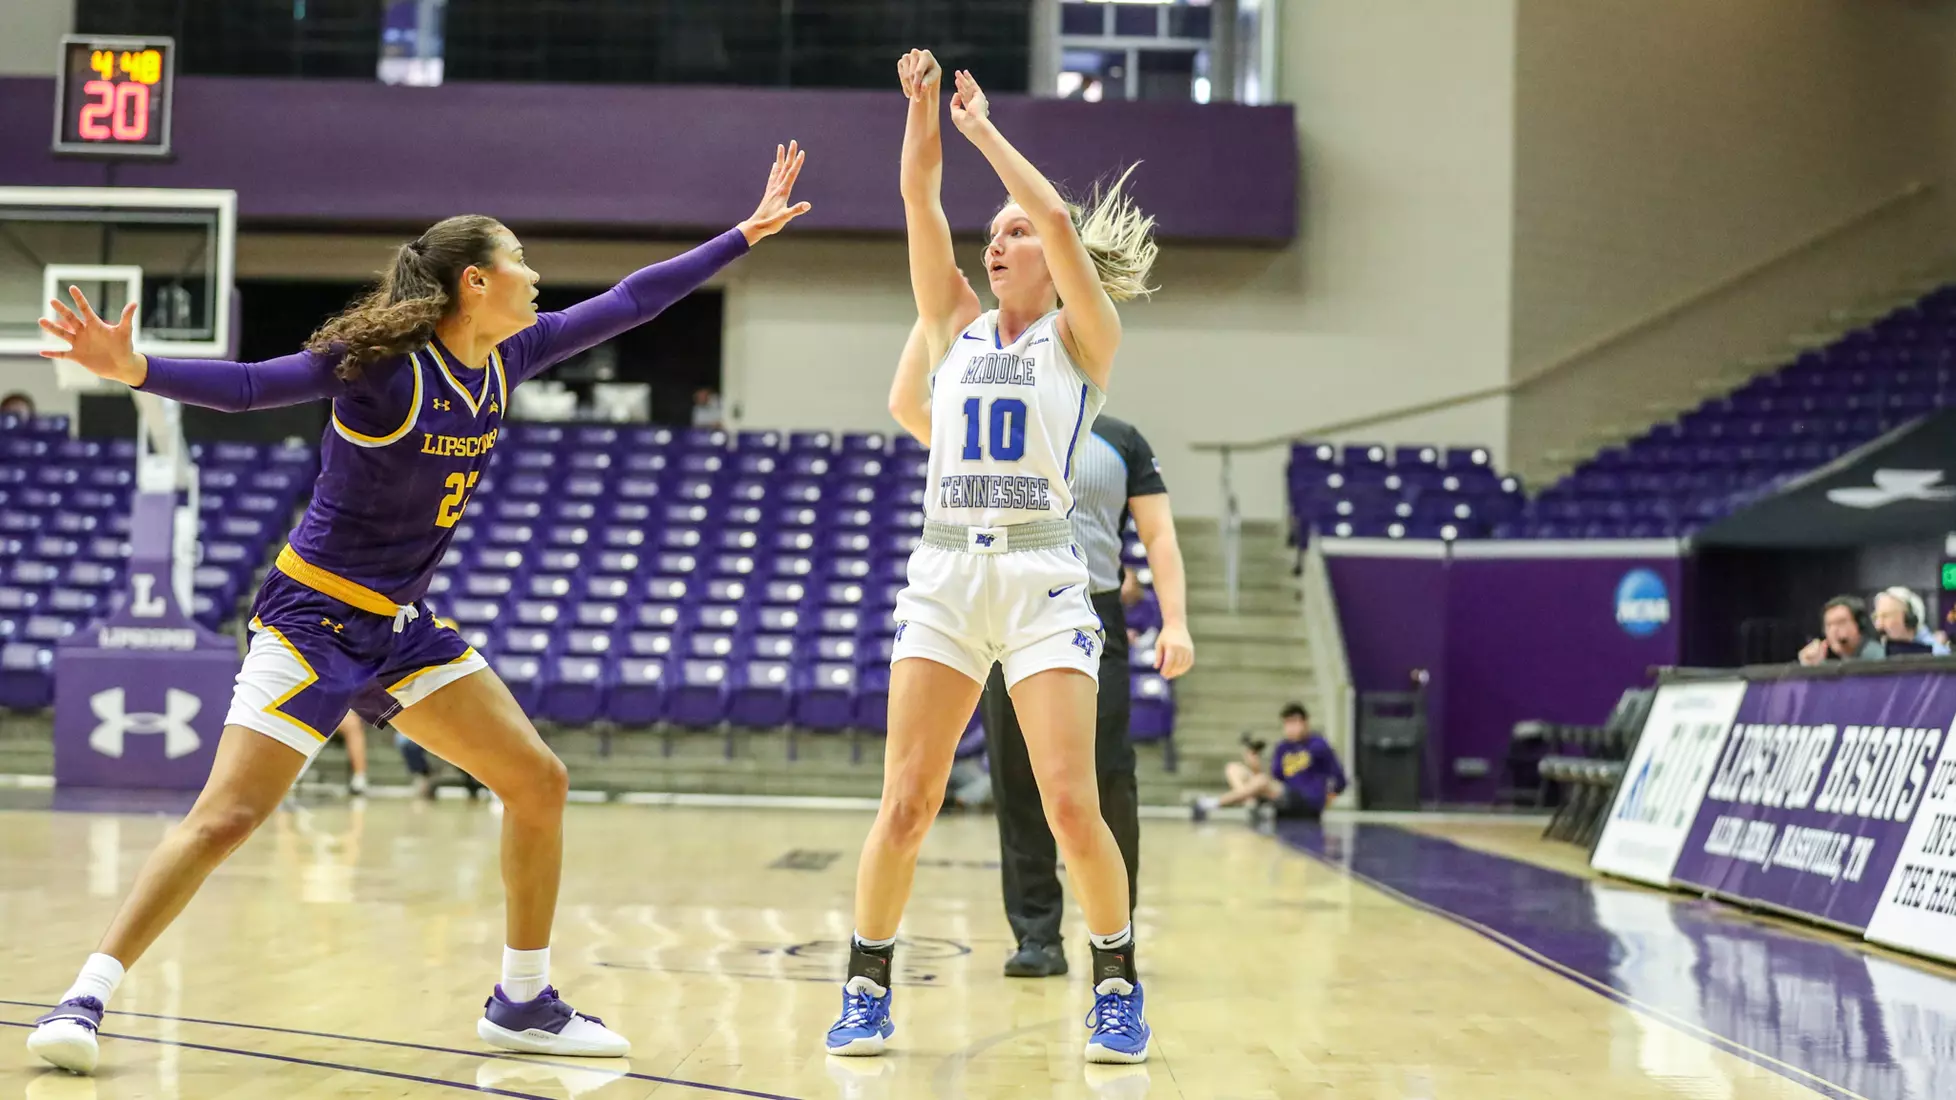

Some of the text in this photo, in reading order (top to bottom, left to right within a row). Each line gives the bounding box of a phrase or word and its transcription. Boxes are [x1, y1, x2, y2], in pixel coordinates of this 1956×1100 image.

[79, 80, 149, 141] 20
[960, 352, 1036, 387] MDDLE
[961, 396, 1029, 463] 10
[940, 475, 1051, 511] TENNESSEE
[131, 573, 167, 618] L
[1813, 724, 1943, 823] BISONS
[1893, 863, 1934, 909] THE
